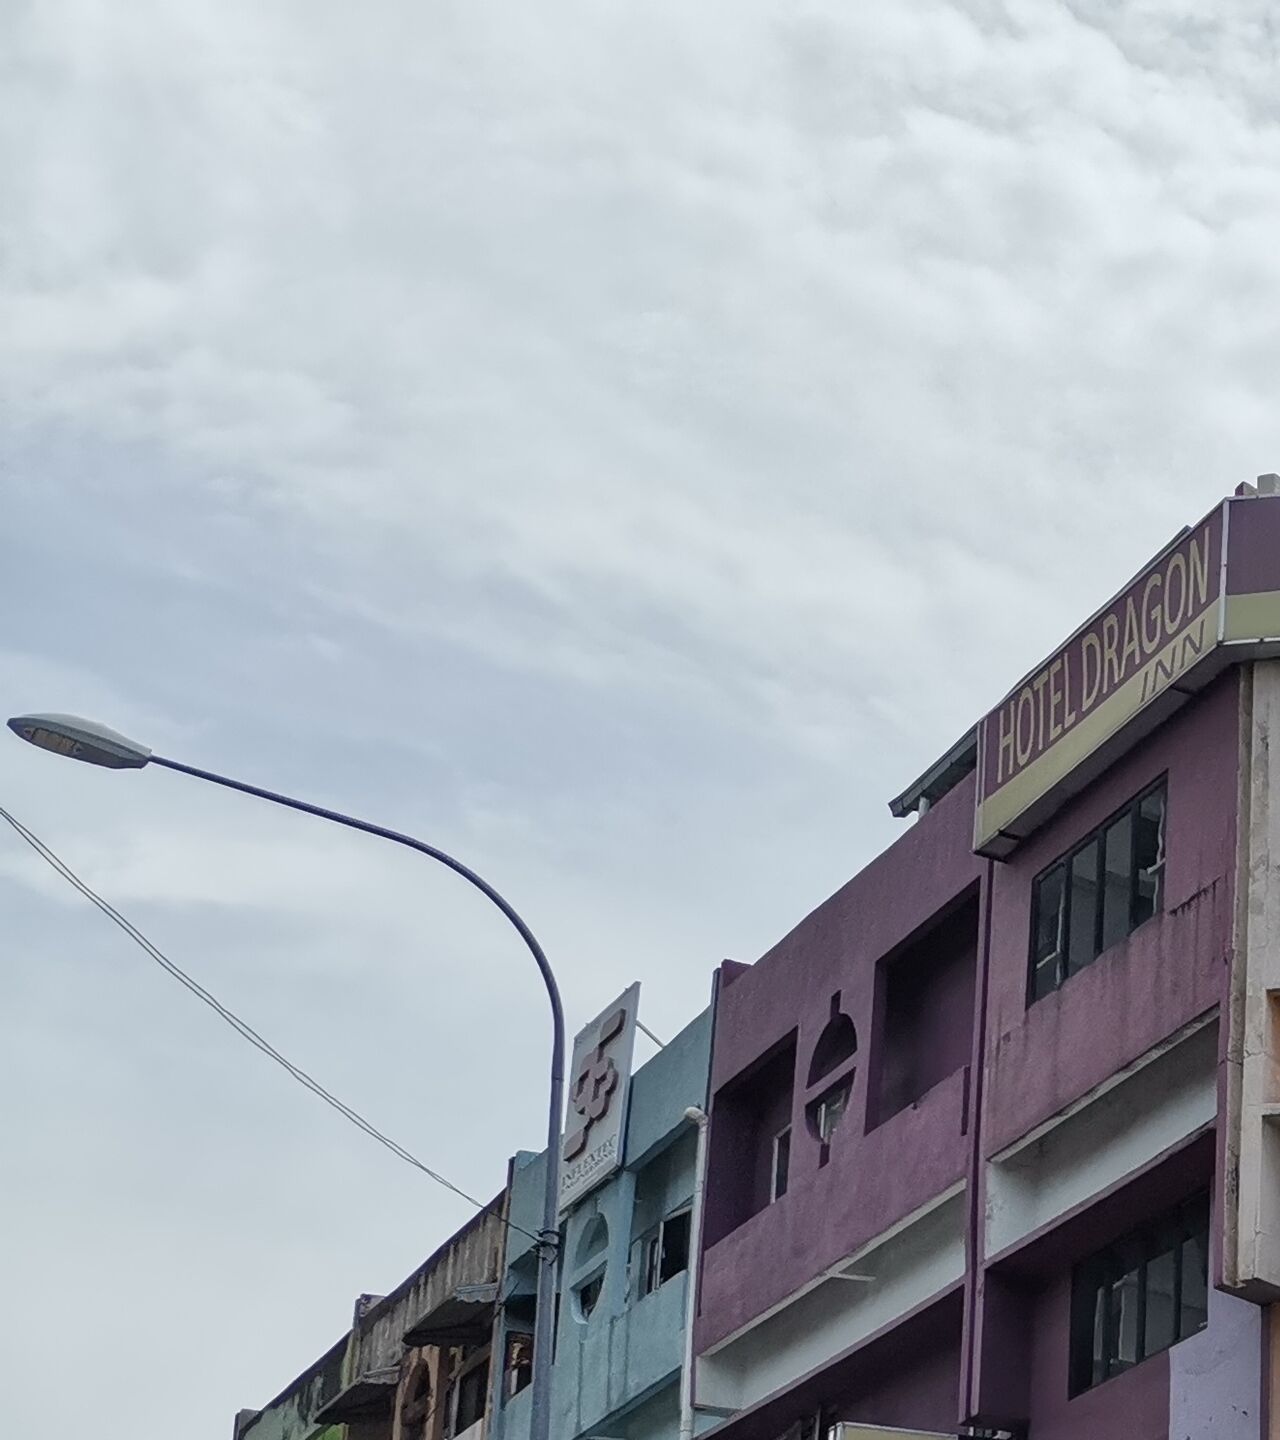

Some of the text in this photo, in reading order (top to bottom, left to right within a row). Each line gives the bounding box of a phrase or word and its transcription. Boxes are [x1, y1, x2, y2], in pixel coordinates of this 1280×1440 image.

[997, 526, 1210, 784] HOTEL DRAGON
[1139, 618, 1206, 704] INN
